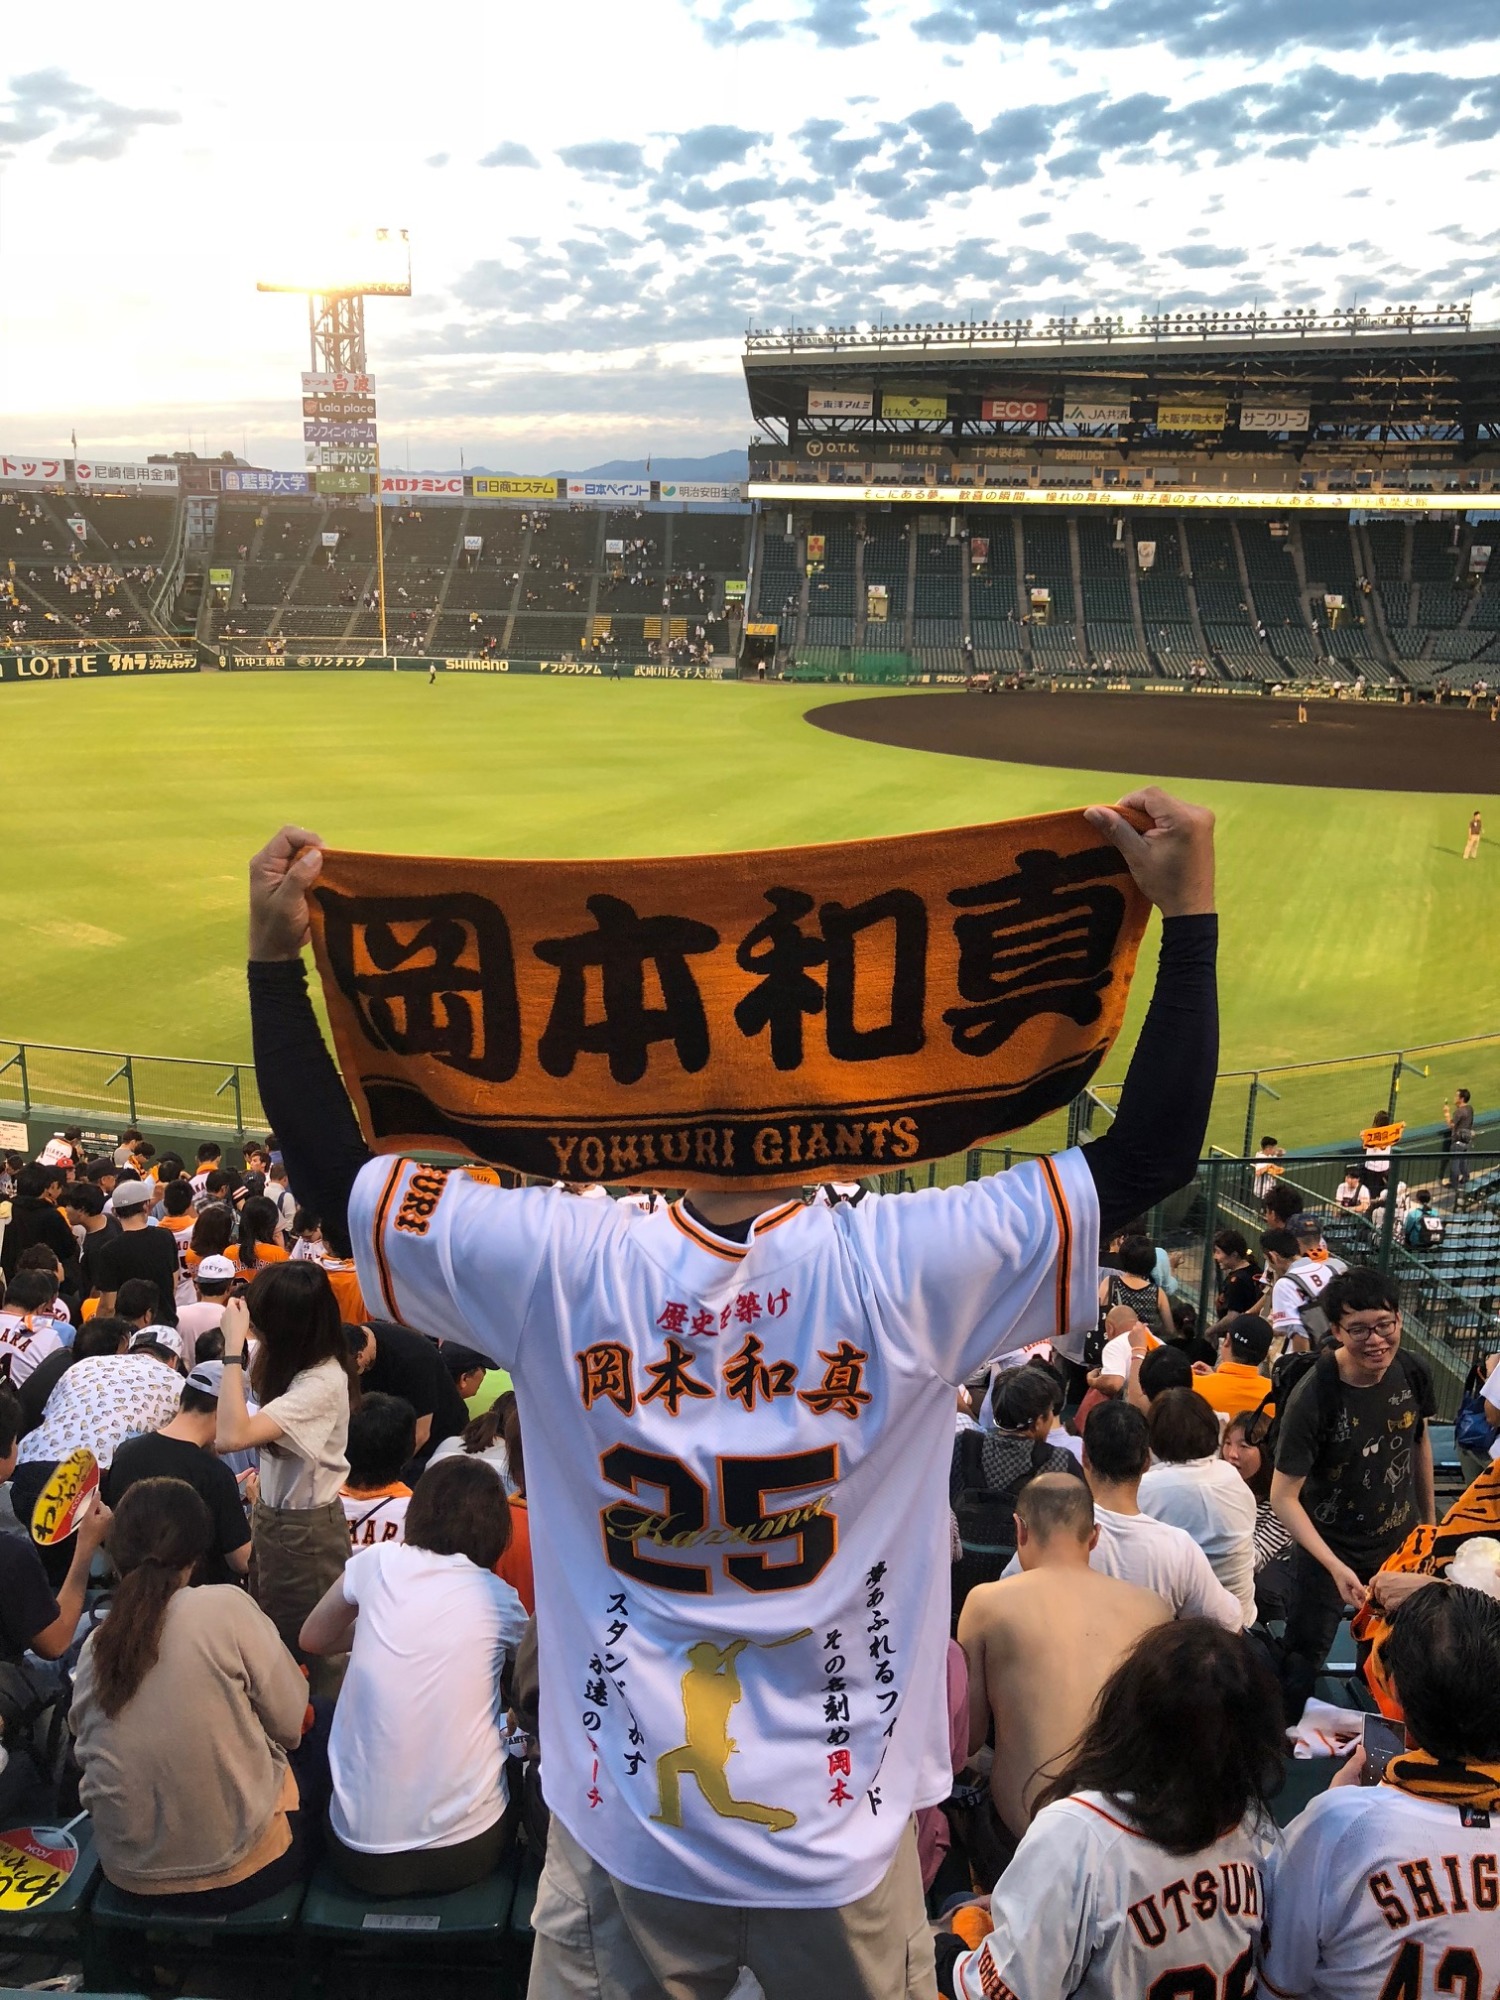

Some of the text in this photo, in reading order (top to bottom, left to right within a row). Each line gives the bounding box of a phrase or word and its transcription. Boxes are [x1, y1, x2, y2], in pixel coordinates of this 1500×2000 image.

[333, 374, 371, 392] 白波
[319, 403, 375, 415] Lala place
[823, 400, 871, 410] 東洋アルミ
[992, 401, 1037, 418] ECC
[1088, 409, 1128, 420] JA共済
[1159, 413, 1224, 425] 大阪学院大学
[1243, 412, 1308, 427] サニクリーン
[826, 442, 860, 454] O.T.K.
[1, 457, 61, 478] トップ
[94, 465, 177, 482] 尼崎信用金庫
[241, 473, 306, 490] 藍野大学
[381, 478, 462, 492] オロナミンC
[488, 480, 554, 494] 日商エステム
[584, 483, 650, 497] 日本ペイント
[679, 486, 741, 498] 明治安田生命
[17, 655, 98, 677] LOTTE
[108, 653, 147, 671] タカラ
[234, 657, 286, 667] 竹中工務店
[313, 657, 366, 667] リンテック
[445, 659, 509, 671] SHIMANO
[550, 663, 602, 674] フジプレアム
[634, 664, 704, 679] 武庫川女子大
[312, 845, 1130, 1083] 岡本和真
[547, 1116, 921, 1178] YOMIURI GIANTS
[575, 1332, 873, 1419] 岡本和真
[598, 1442, 840, 1597] 25
[605, 1592, 648, 1777] スタンかす
[865, 1560, 899, 1817] 夢あふれるフィド
[1367, 1853, 1500, 1931] SHIG
